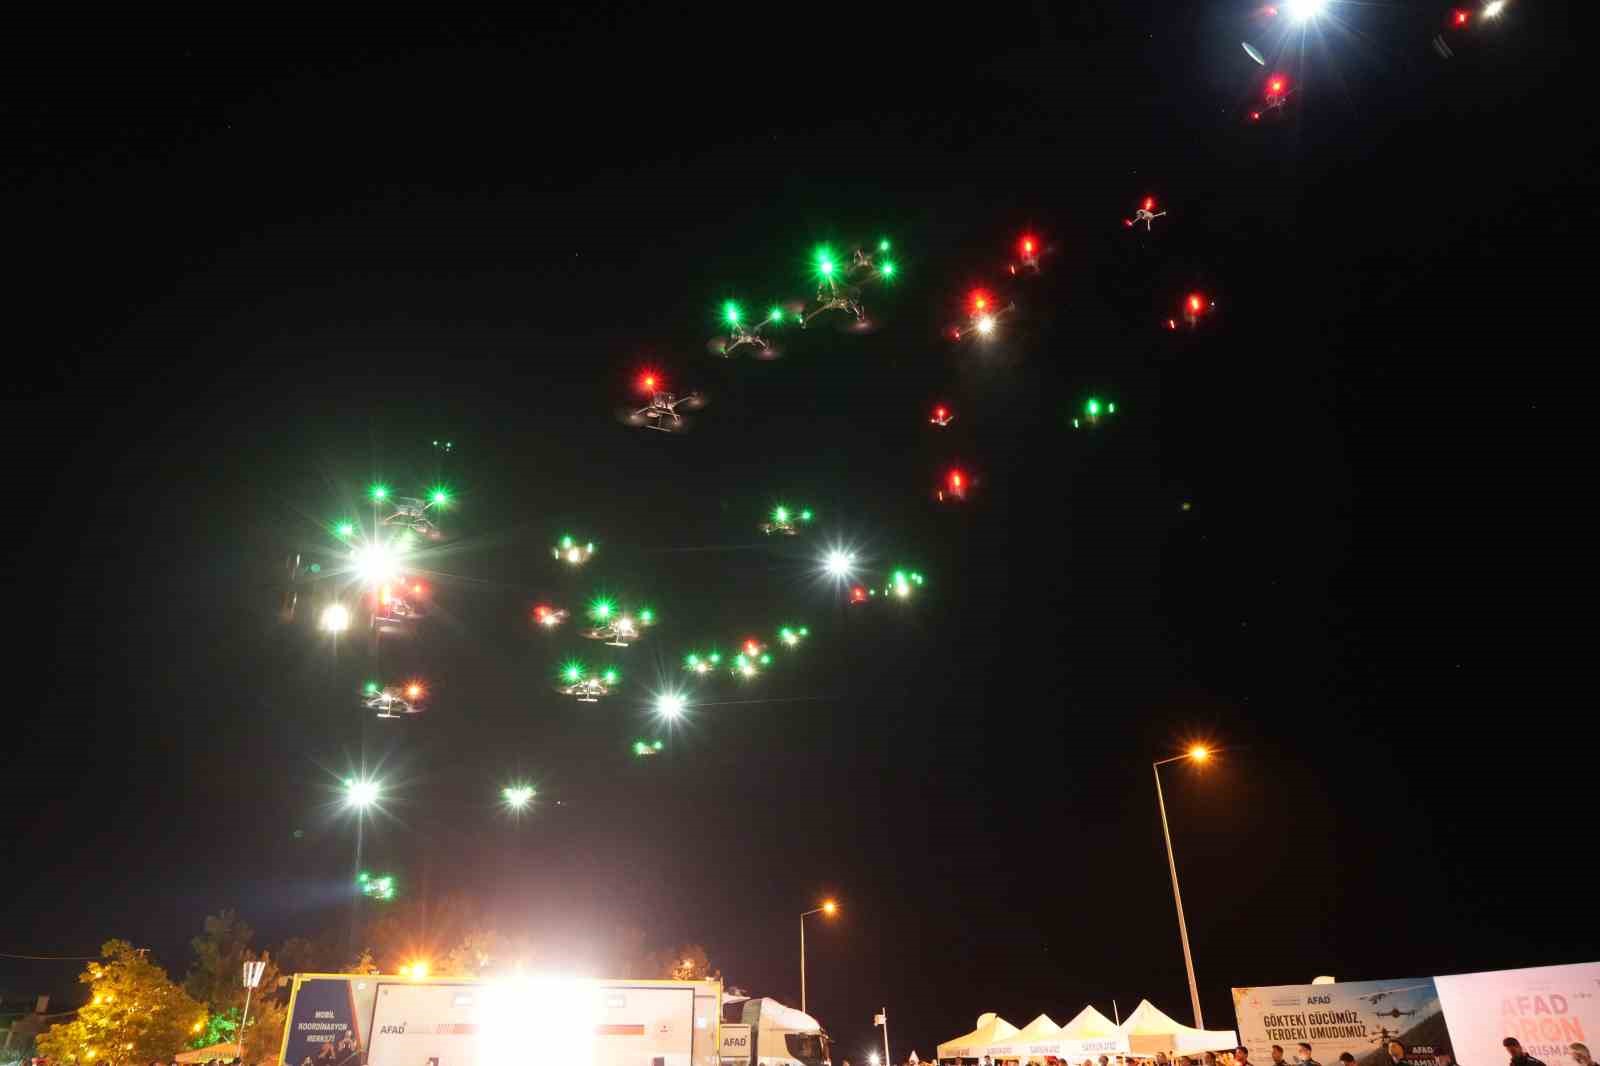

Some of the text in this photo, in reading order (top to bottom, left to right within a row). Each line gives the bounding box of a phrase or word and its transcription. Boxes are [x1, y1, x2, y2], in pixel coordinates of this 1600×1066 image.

[1307, 996, 1331, 1005] AFAD
[1502, 993, 1569, 1016] AFAD
[1264, 1011, 1306, 1027] GÖKTEKİ
[380, 1025, 405, 1035] AFAD
[1266, 1025, 1368, 1041] YERDEKİ UMUDUMUZ
[724, 1037, 746, 1046] AFAD
